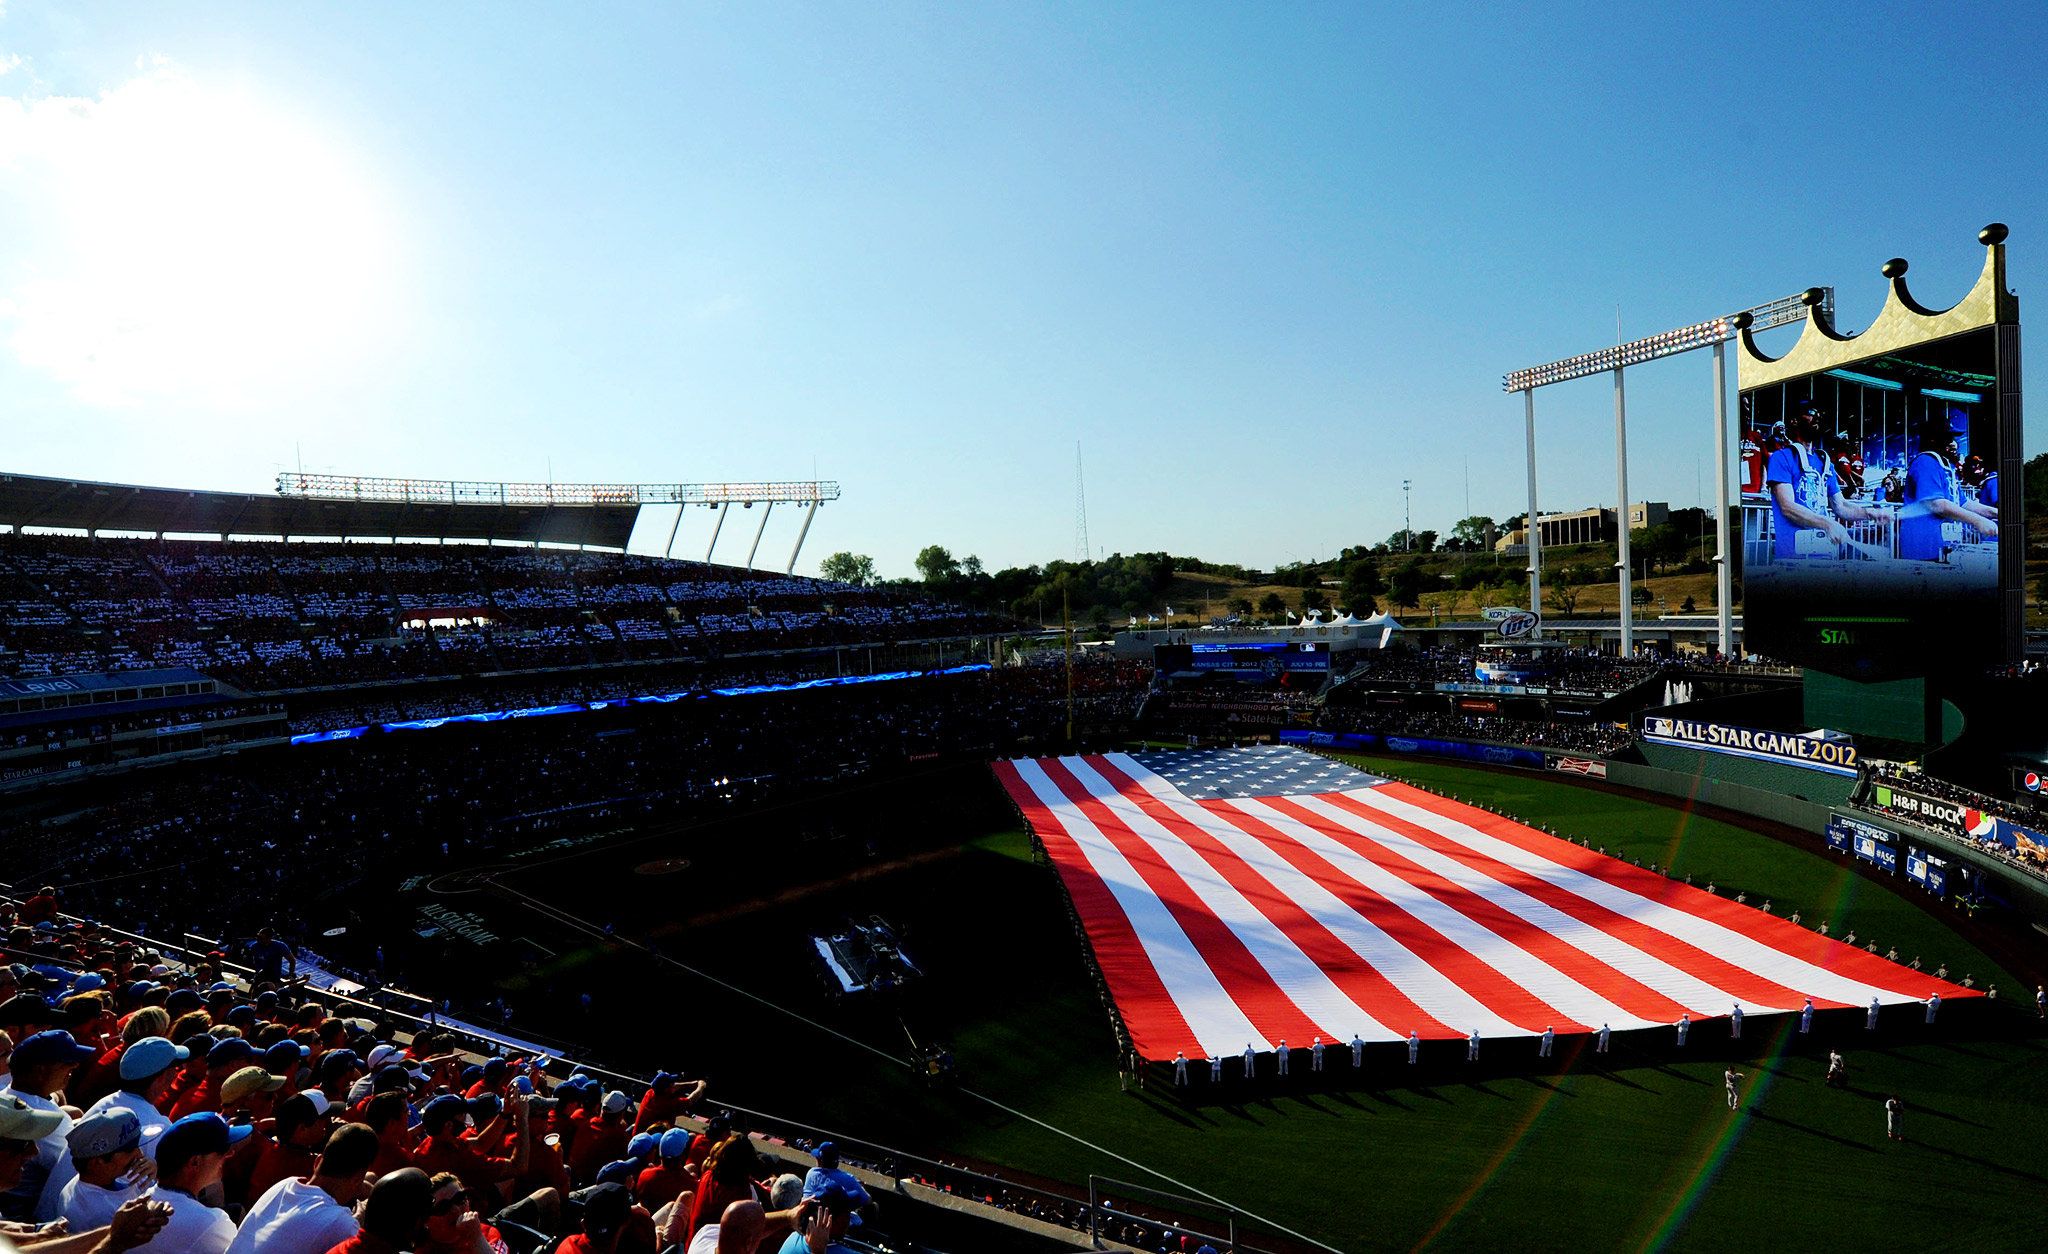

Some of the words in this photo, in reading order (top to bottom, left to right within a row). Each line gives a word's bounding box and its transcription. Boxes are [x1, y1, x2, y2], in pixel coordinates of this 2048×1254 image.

[1211, 613, 1239, 627] Royals
[1292, 628, 1304, 636] 20
[1315, 626, 1326, 635] 10
[1341, 626, 1348, 635] 5
[1504, 617, 1533, 636] Lite
[1135, 632, 1146, 641] 42
[6, 679, 80, 694] Level
[48, 742, 61, 750] FOX
[1753, 733, 1810, 757] GAME
[1809, 741, 1857, 767] 2012
[67, 760, 82, 768] FOX
[21, 766, 44, 777] GAME
[1893, 794, 1918, 811] H&R
[1921, 802, 1961, 825] BLOCK
[1876, 849, 1896, 864] #ASG
